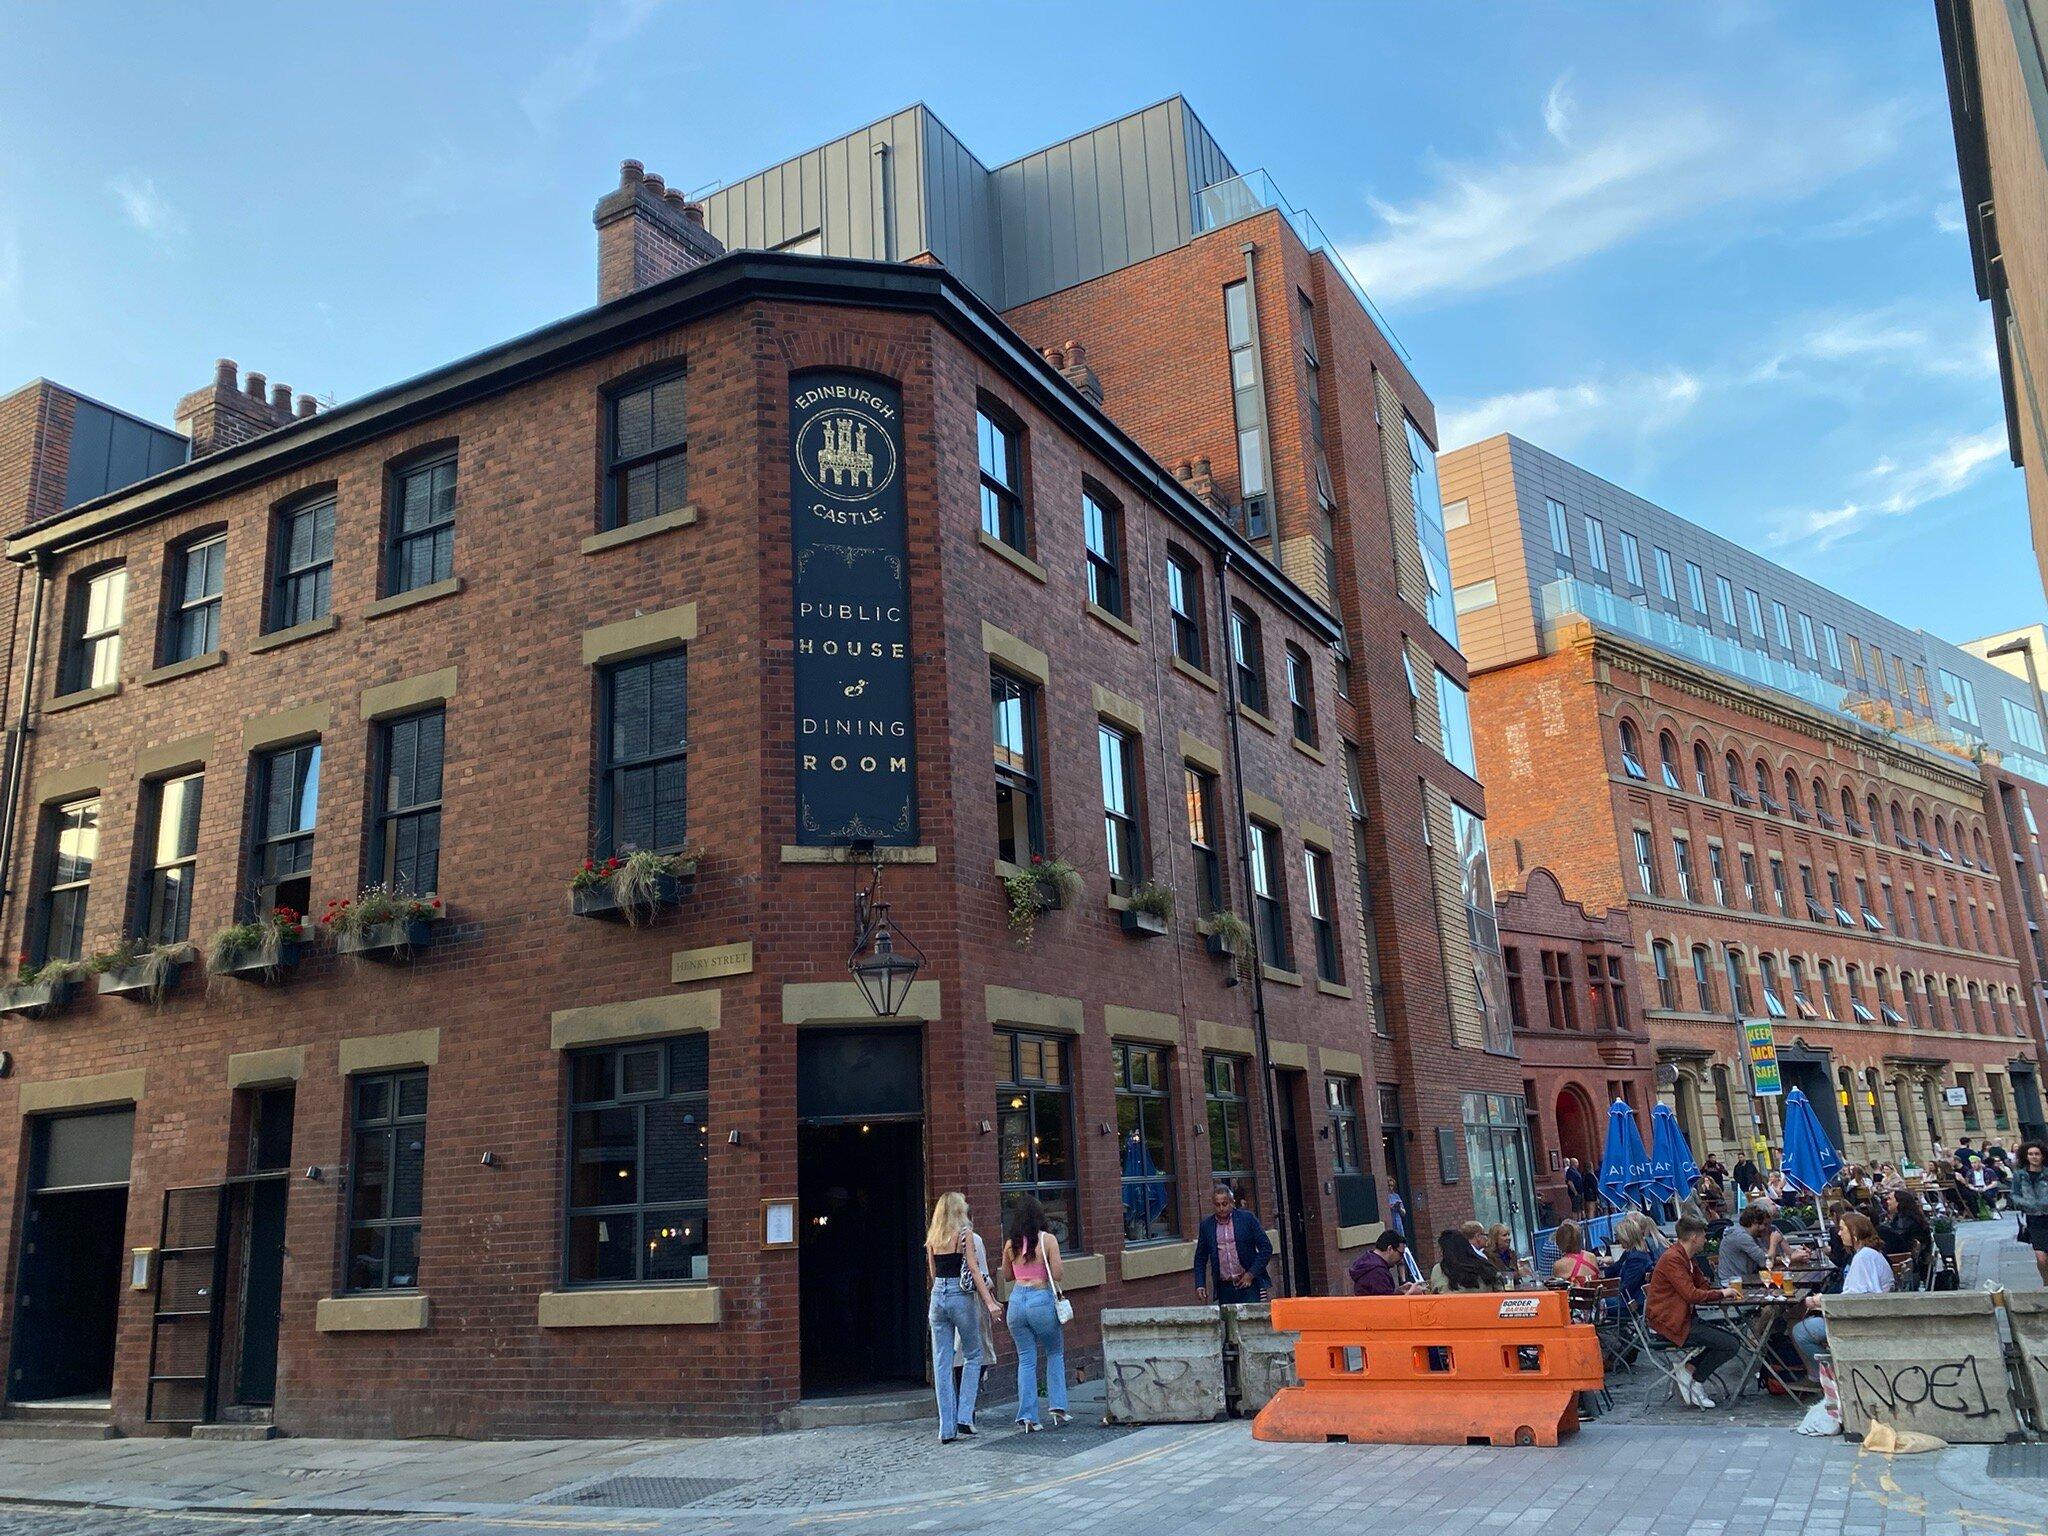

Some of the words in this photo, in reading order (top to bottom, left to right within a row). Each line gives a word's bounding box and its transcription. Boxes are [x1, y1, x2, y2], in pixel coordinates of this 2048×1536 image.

[795, 386, 894, 419] EDINBURGH
[813, 503, 883, 525] CASTLE
[800, 602, 901, 621] PUBLIC
[799, 639, 904, 658] HOUSE
[803, 718, 905, 737] DINING
[803, 755, 907, 773] ROOM
[676, 959, 709, 972] HENRY
[711, 953, 748, 966] STREET
[1747, 1028, 1771, 1042] KEEP
[1751, 1045, 1775, 1061] MCR
[1755, 1064, 1777, 1078] SAFE
